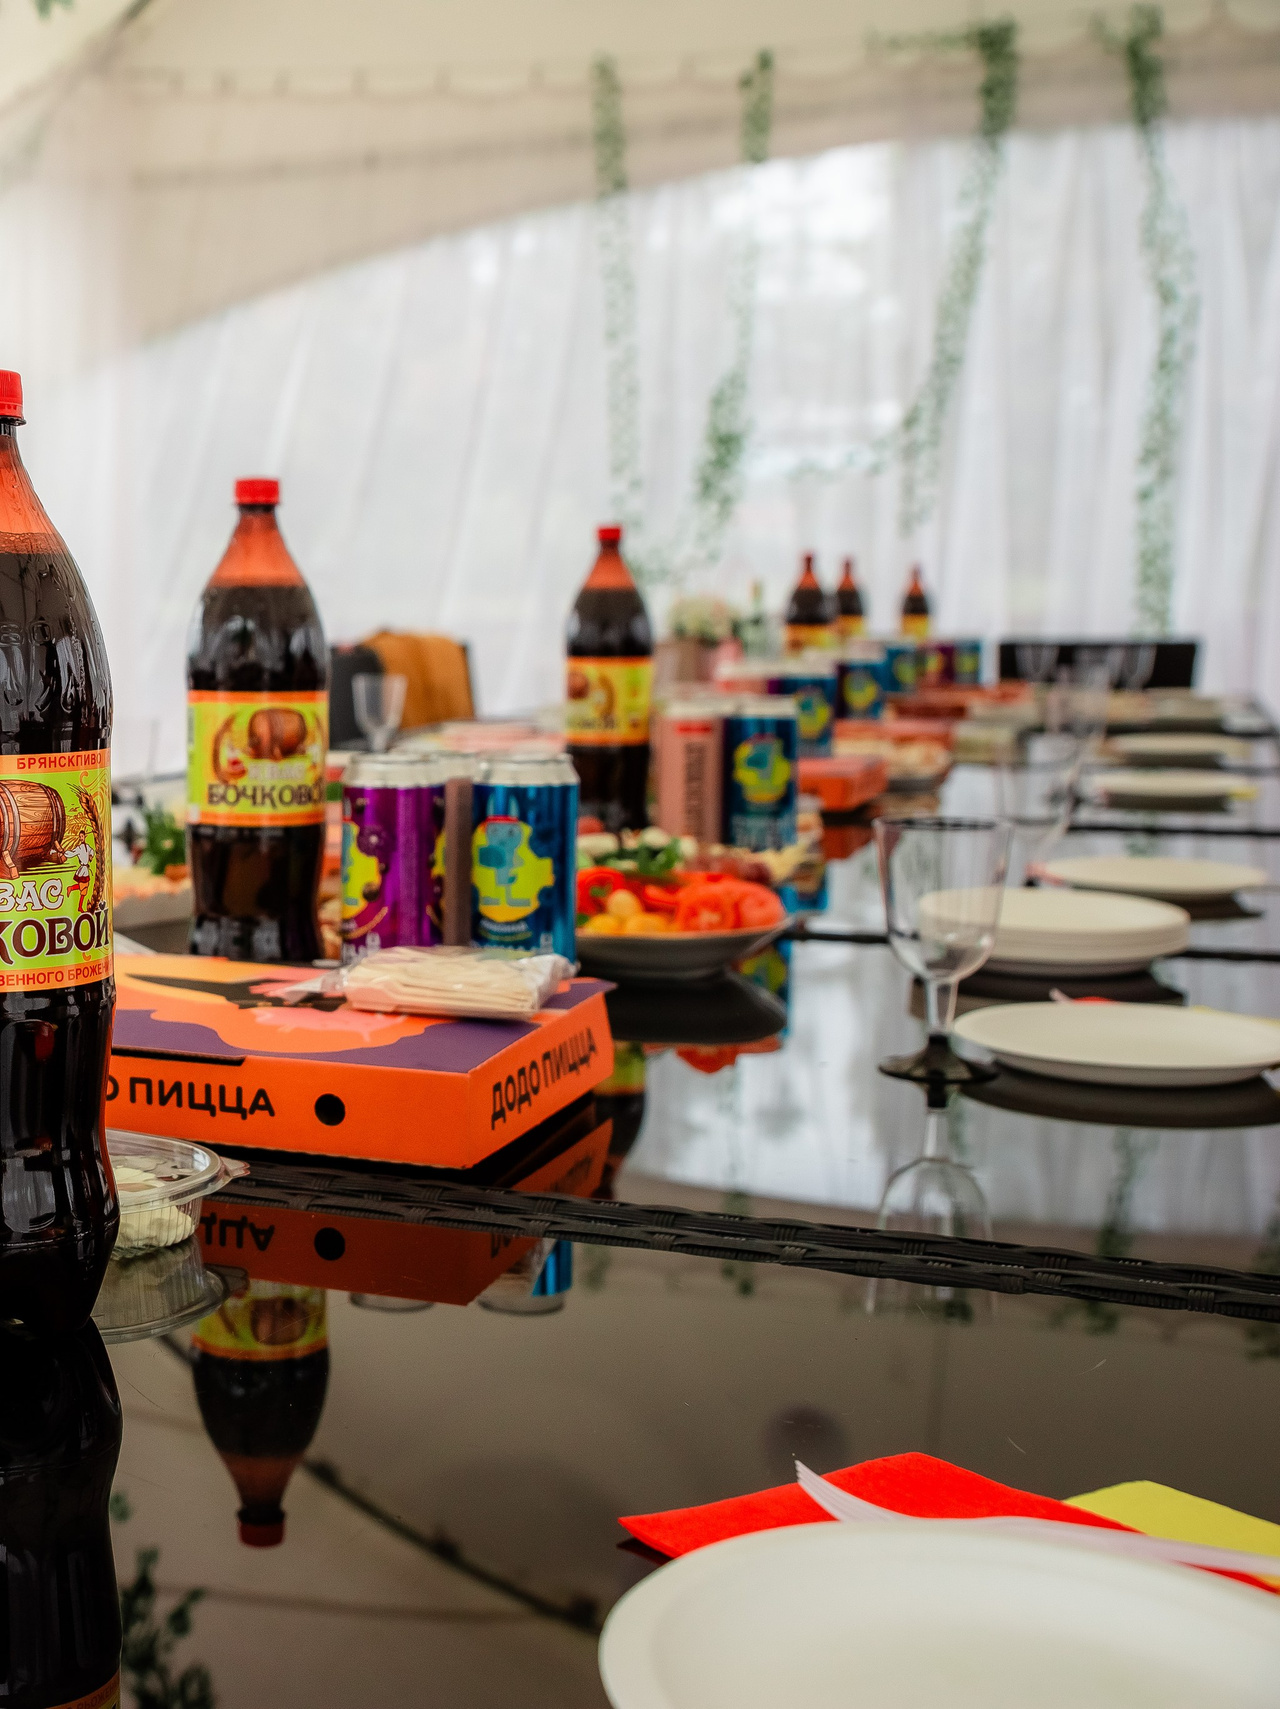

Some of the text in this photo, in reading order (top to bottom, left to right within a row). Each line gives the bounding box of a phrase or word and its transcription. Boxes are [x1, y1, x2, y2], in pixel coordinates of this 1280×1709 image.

[16, 752, 102, 770] БРЯНСКПИВО
[129, 1076, 275, 1121] ПИЦЦА
[490, 1059, 540, 1131] ДОДО
